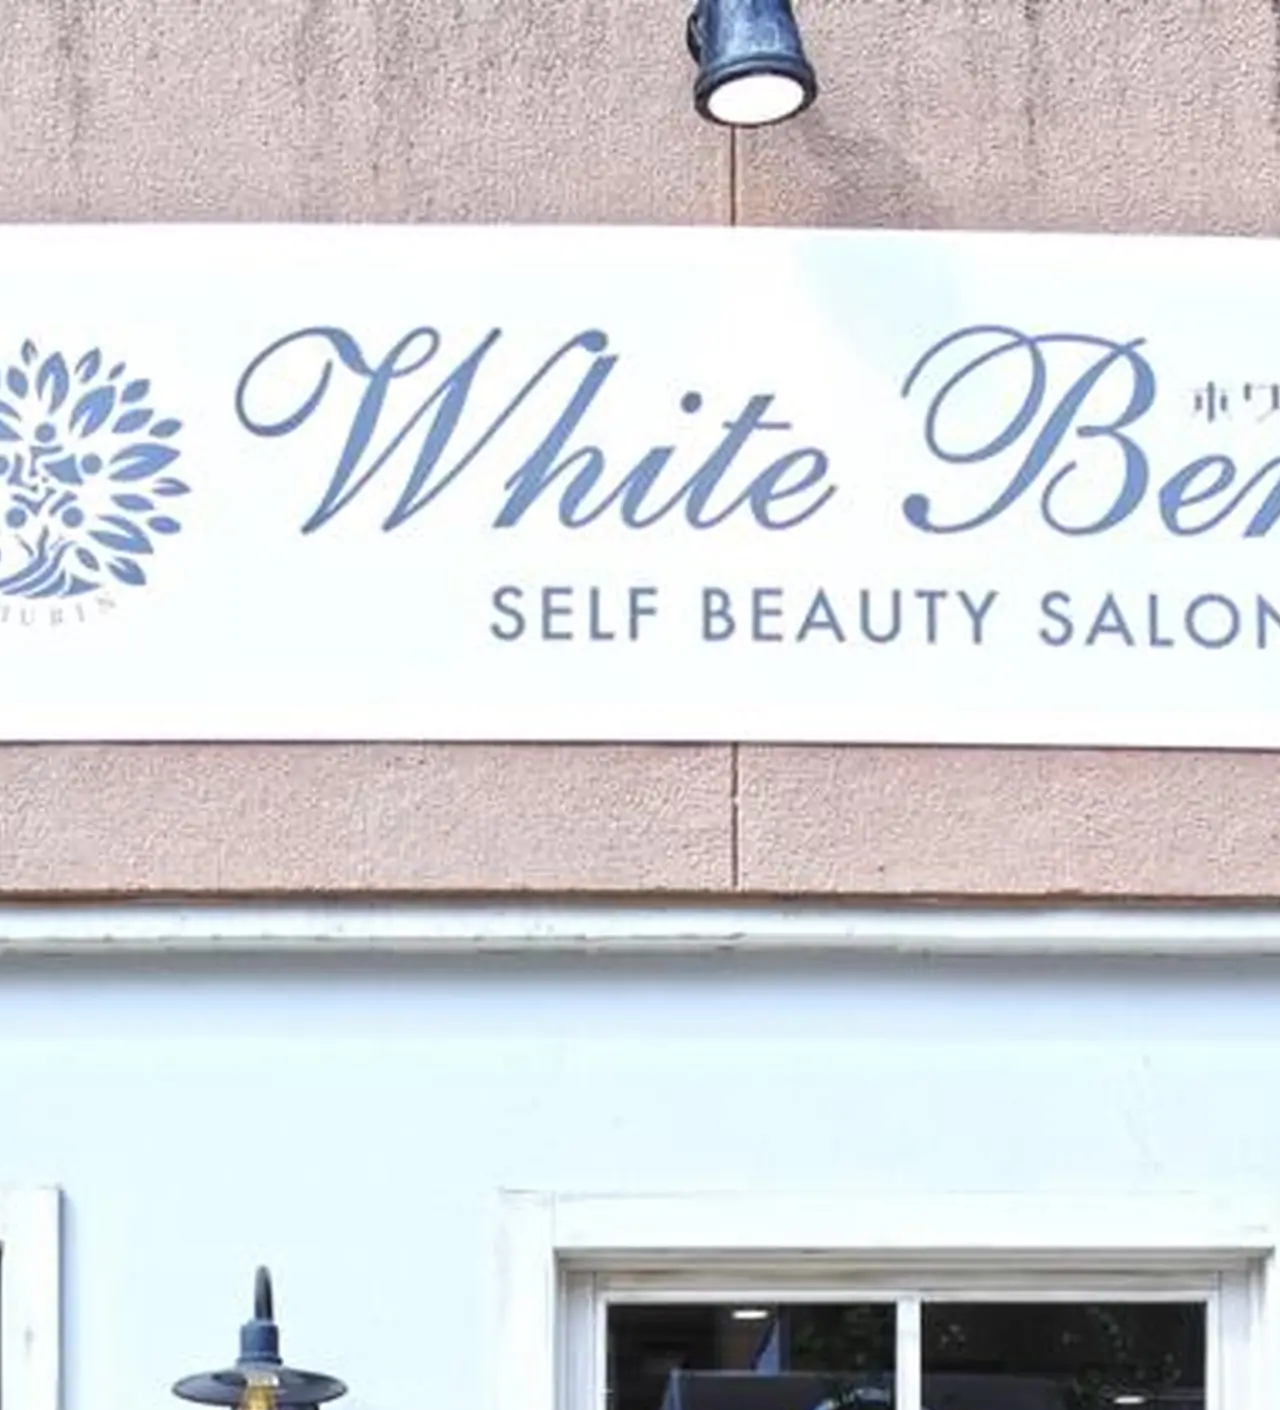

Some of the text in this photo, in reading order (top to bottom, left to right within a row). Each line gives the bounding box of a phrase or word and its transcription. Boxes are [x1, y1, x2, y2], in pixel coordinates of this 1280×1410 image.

[234, 325, 840, 536] White
[489, 585, 659, 642] SELF
[700, 586, 1001, 648] BEAUTY
